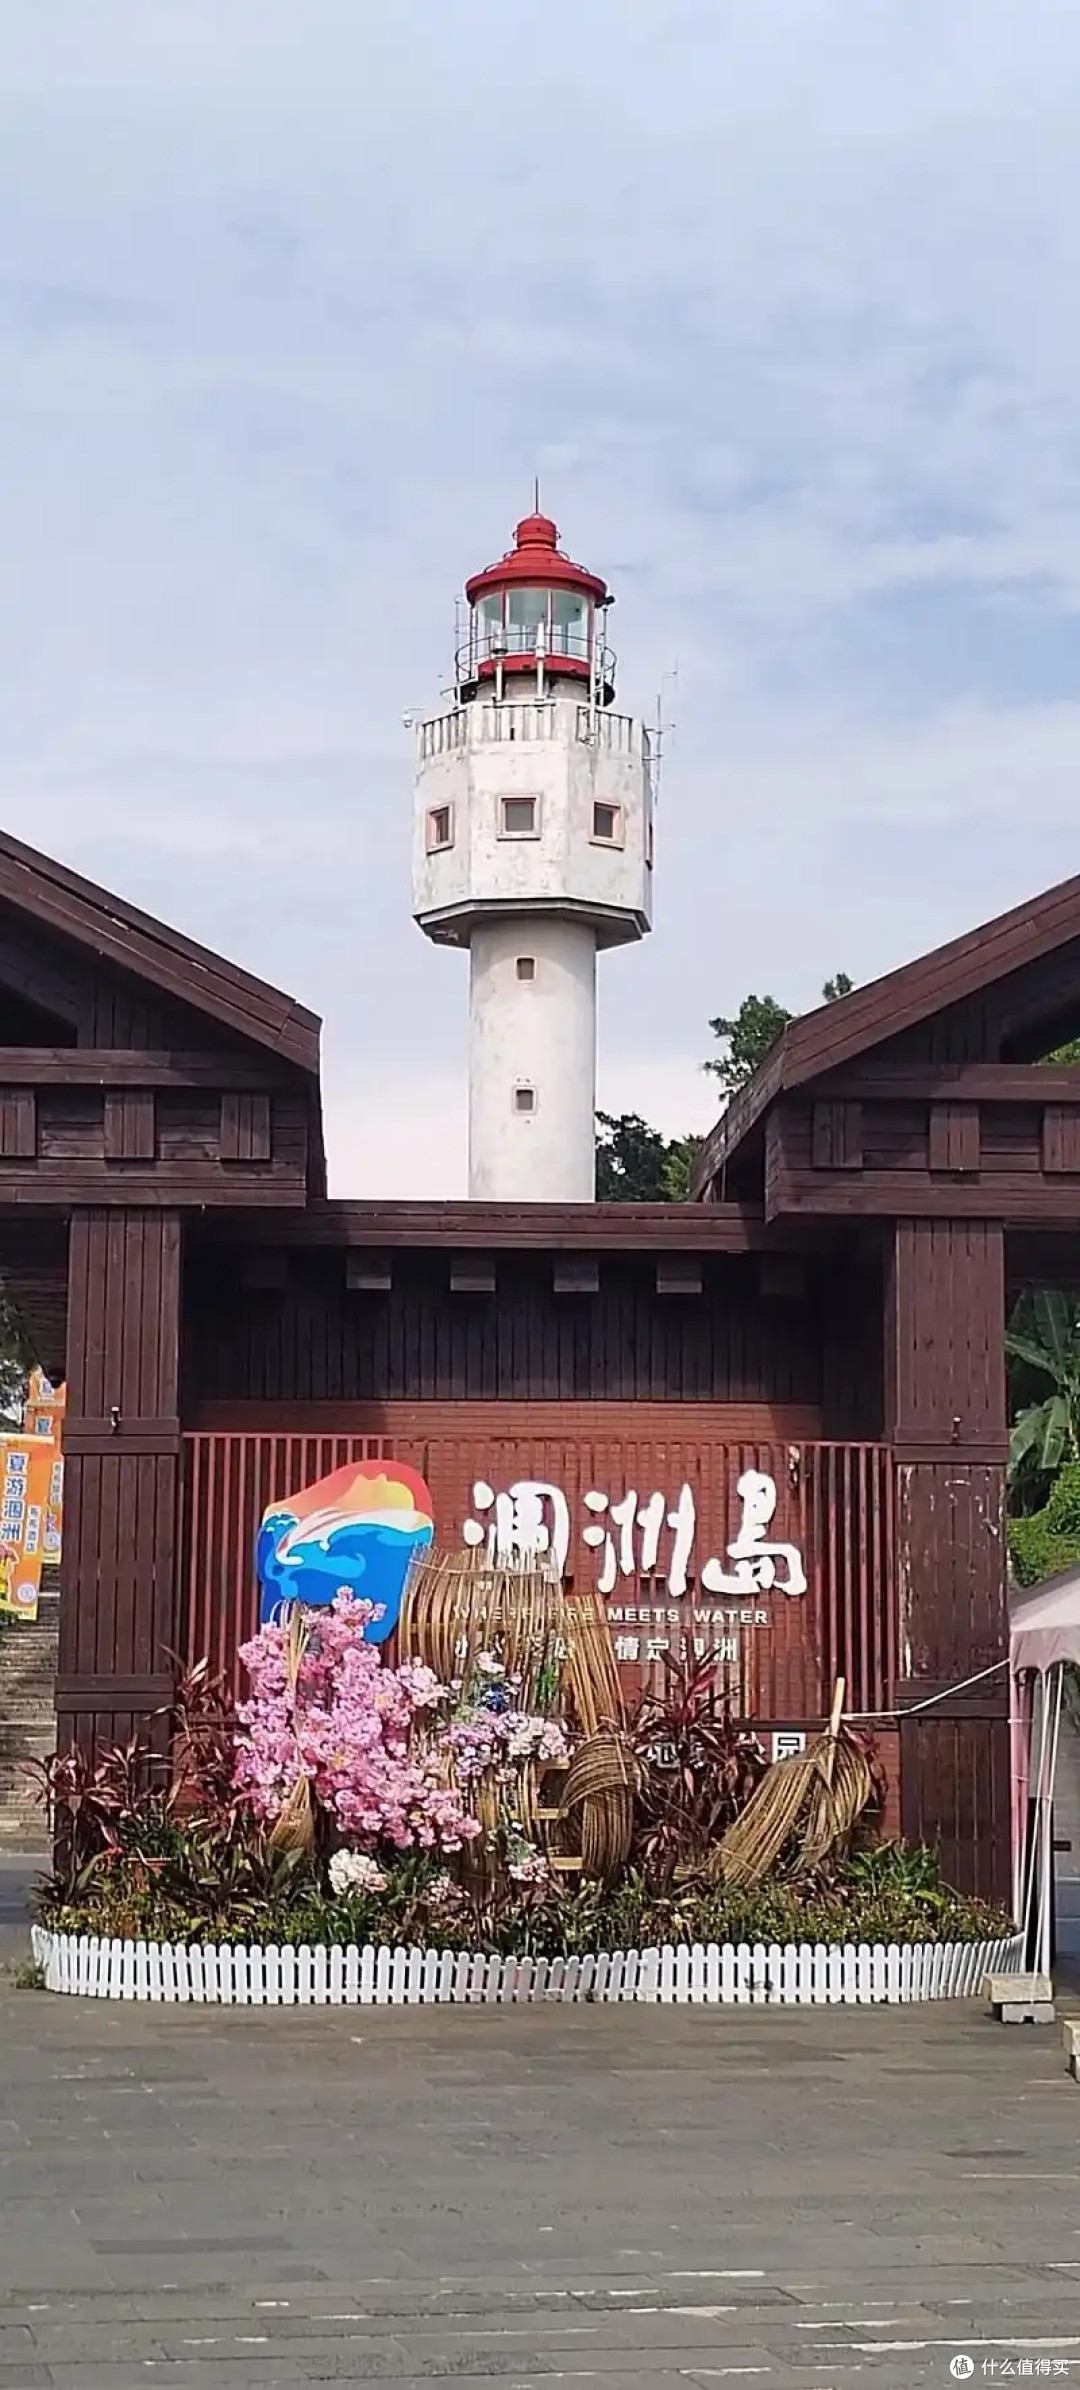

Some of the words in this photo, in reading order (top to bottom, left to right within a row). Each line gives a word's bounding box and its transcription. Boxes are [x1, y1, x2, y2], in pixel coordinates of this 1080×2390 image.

[463, 1469, 808, 1597] 涠洲岛
[607, 1608, 680, 1622] MEETS
[694, 1609, 768, 1624] WATER
